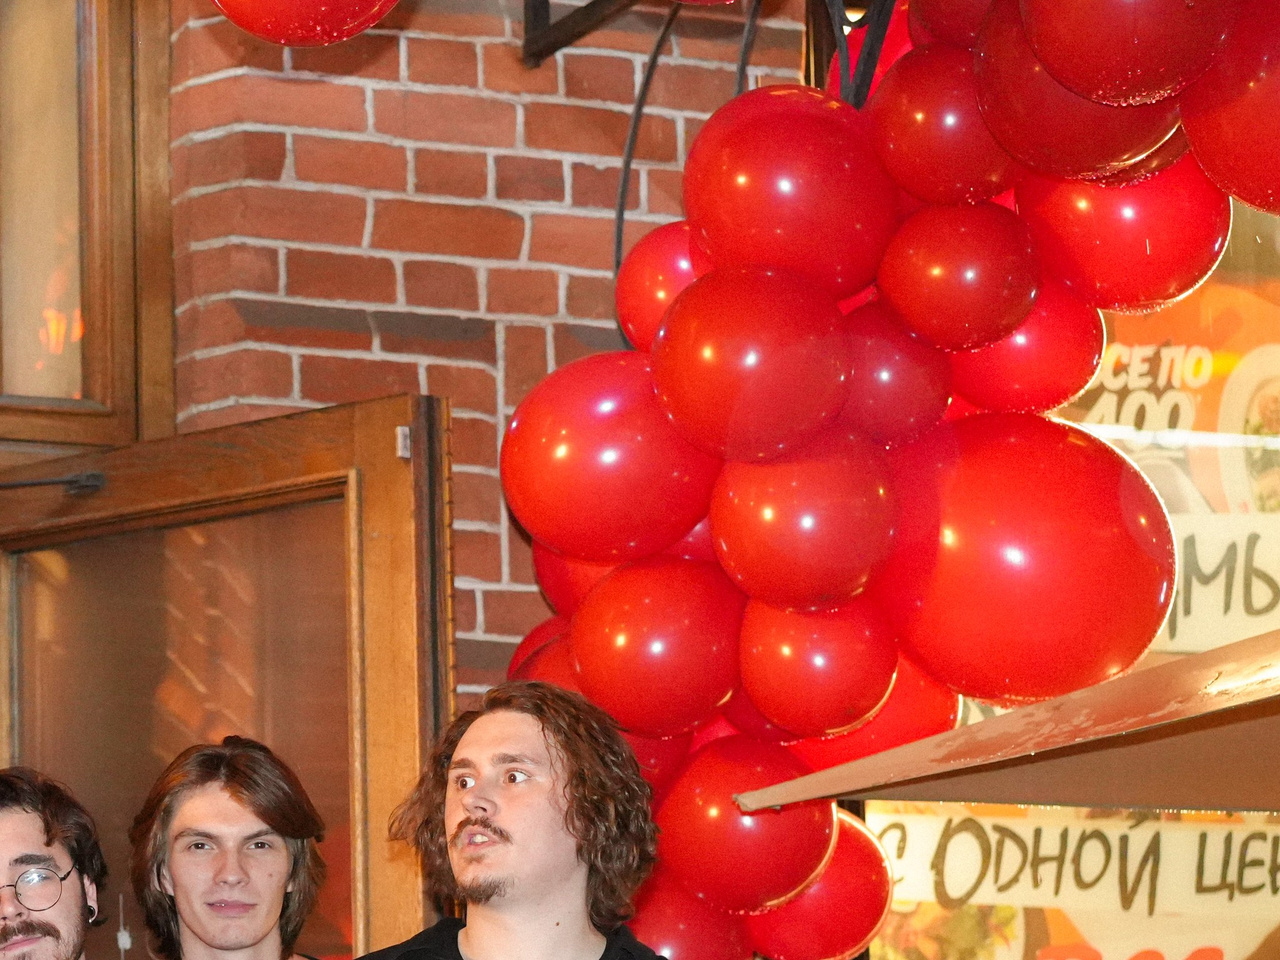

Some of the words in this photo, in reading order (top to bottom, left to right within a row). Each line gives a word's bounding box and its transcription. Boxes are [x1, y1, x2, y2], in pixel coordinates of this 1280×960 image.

[1086, 342, 1157, 391] СЕ
[1157, 345, 1213, 391] ПО
[930, 816, 1161, 917] ОДНОЙ
